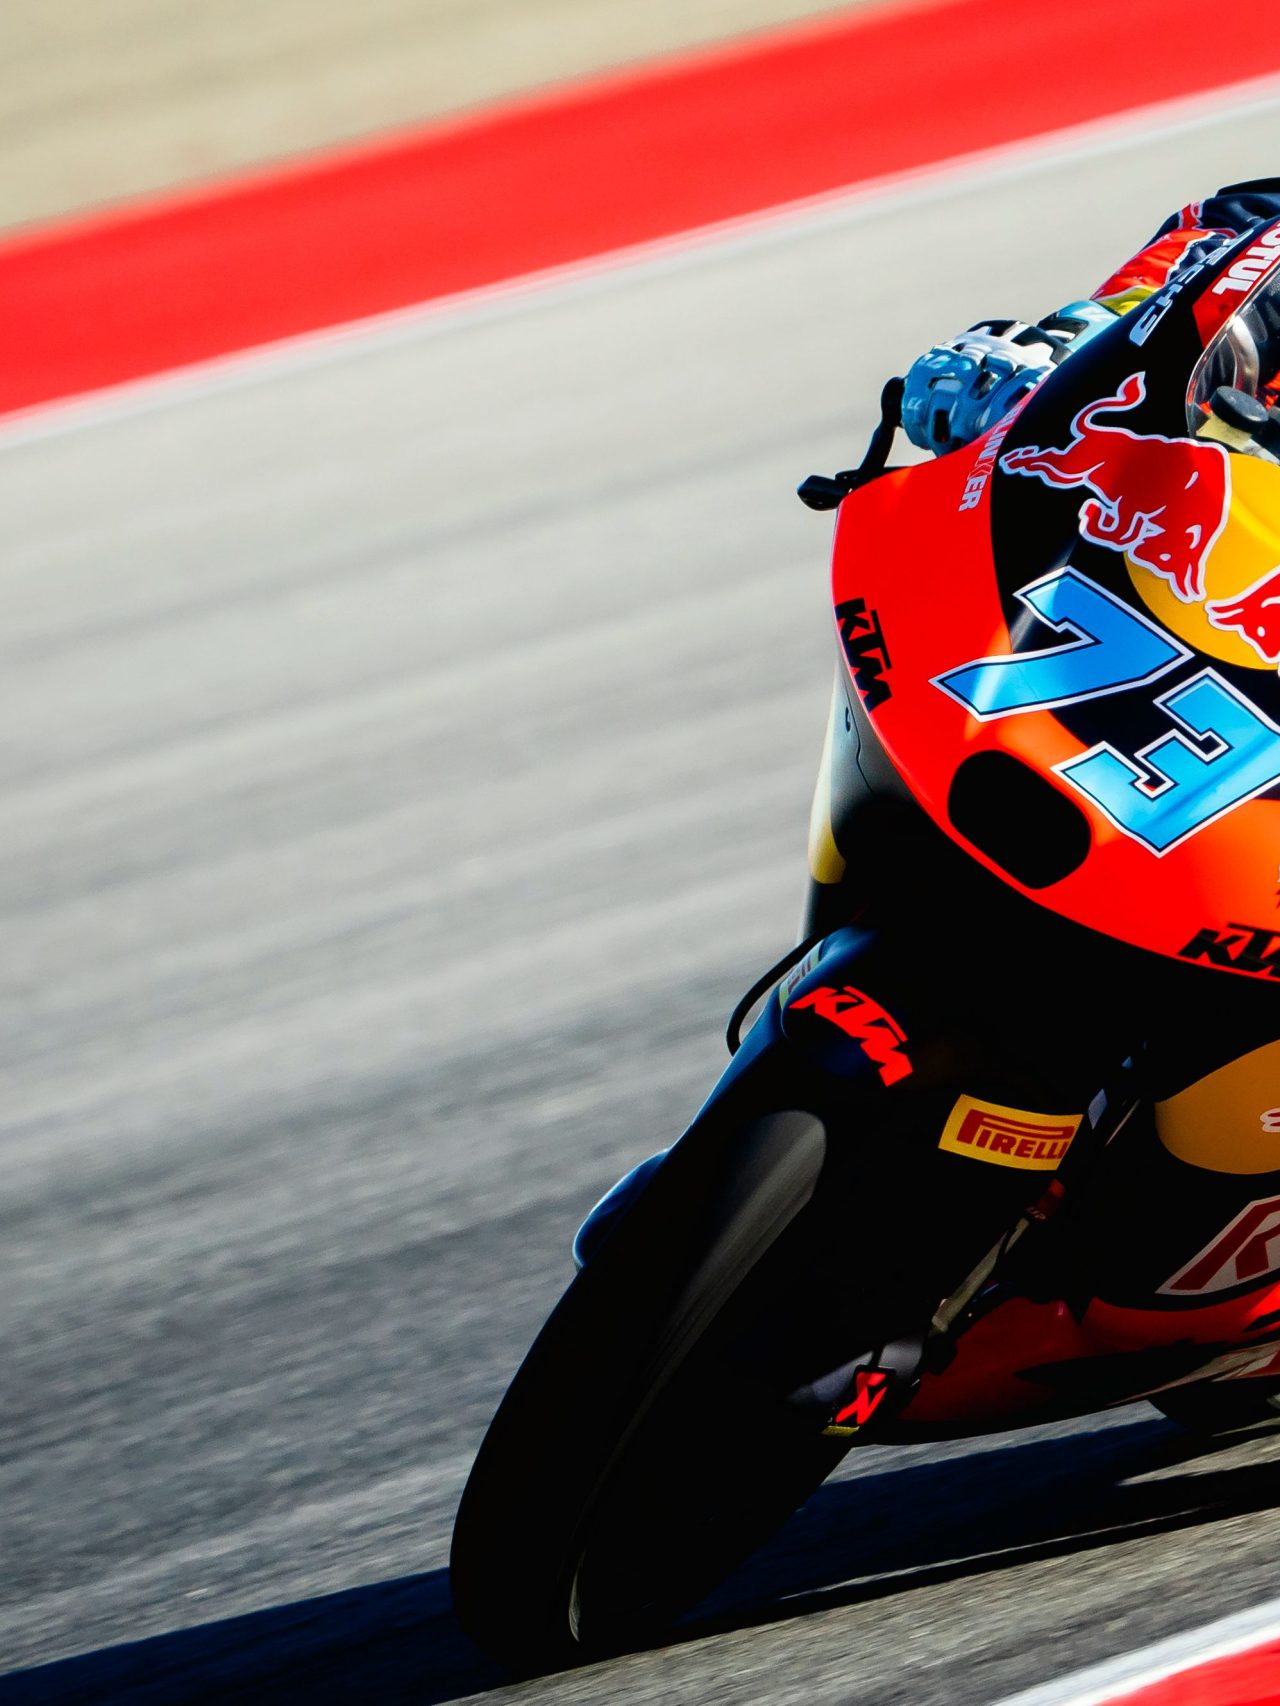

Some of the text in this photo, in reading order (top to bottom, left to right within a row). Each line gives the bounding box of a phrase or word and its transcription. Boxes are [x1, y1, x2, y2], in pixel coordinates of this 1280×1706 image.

[1128, 228, 1255, 347] TECH3
[834, 597, 893, 713] KTM
[788, 985, 914, 1088] KTM
[955, 1108, 1075, 1161] PIRELLI
